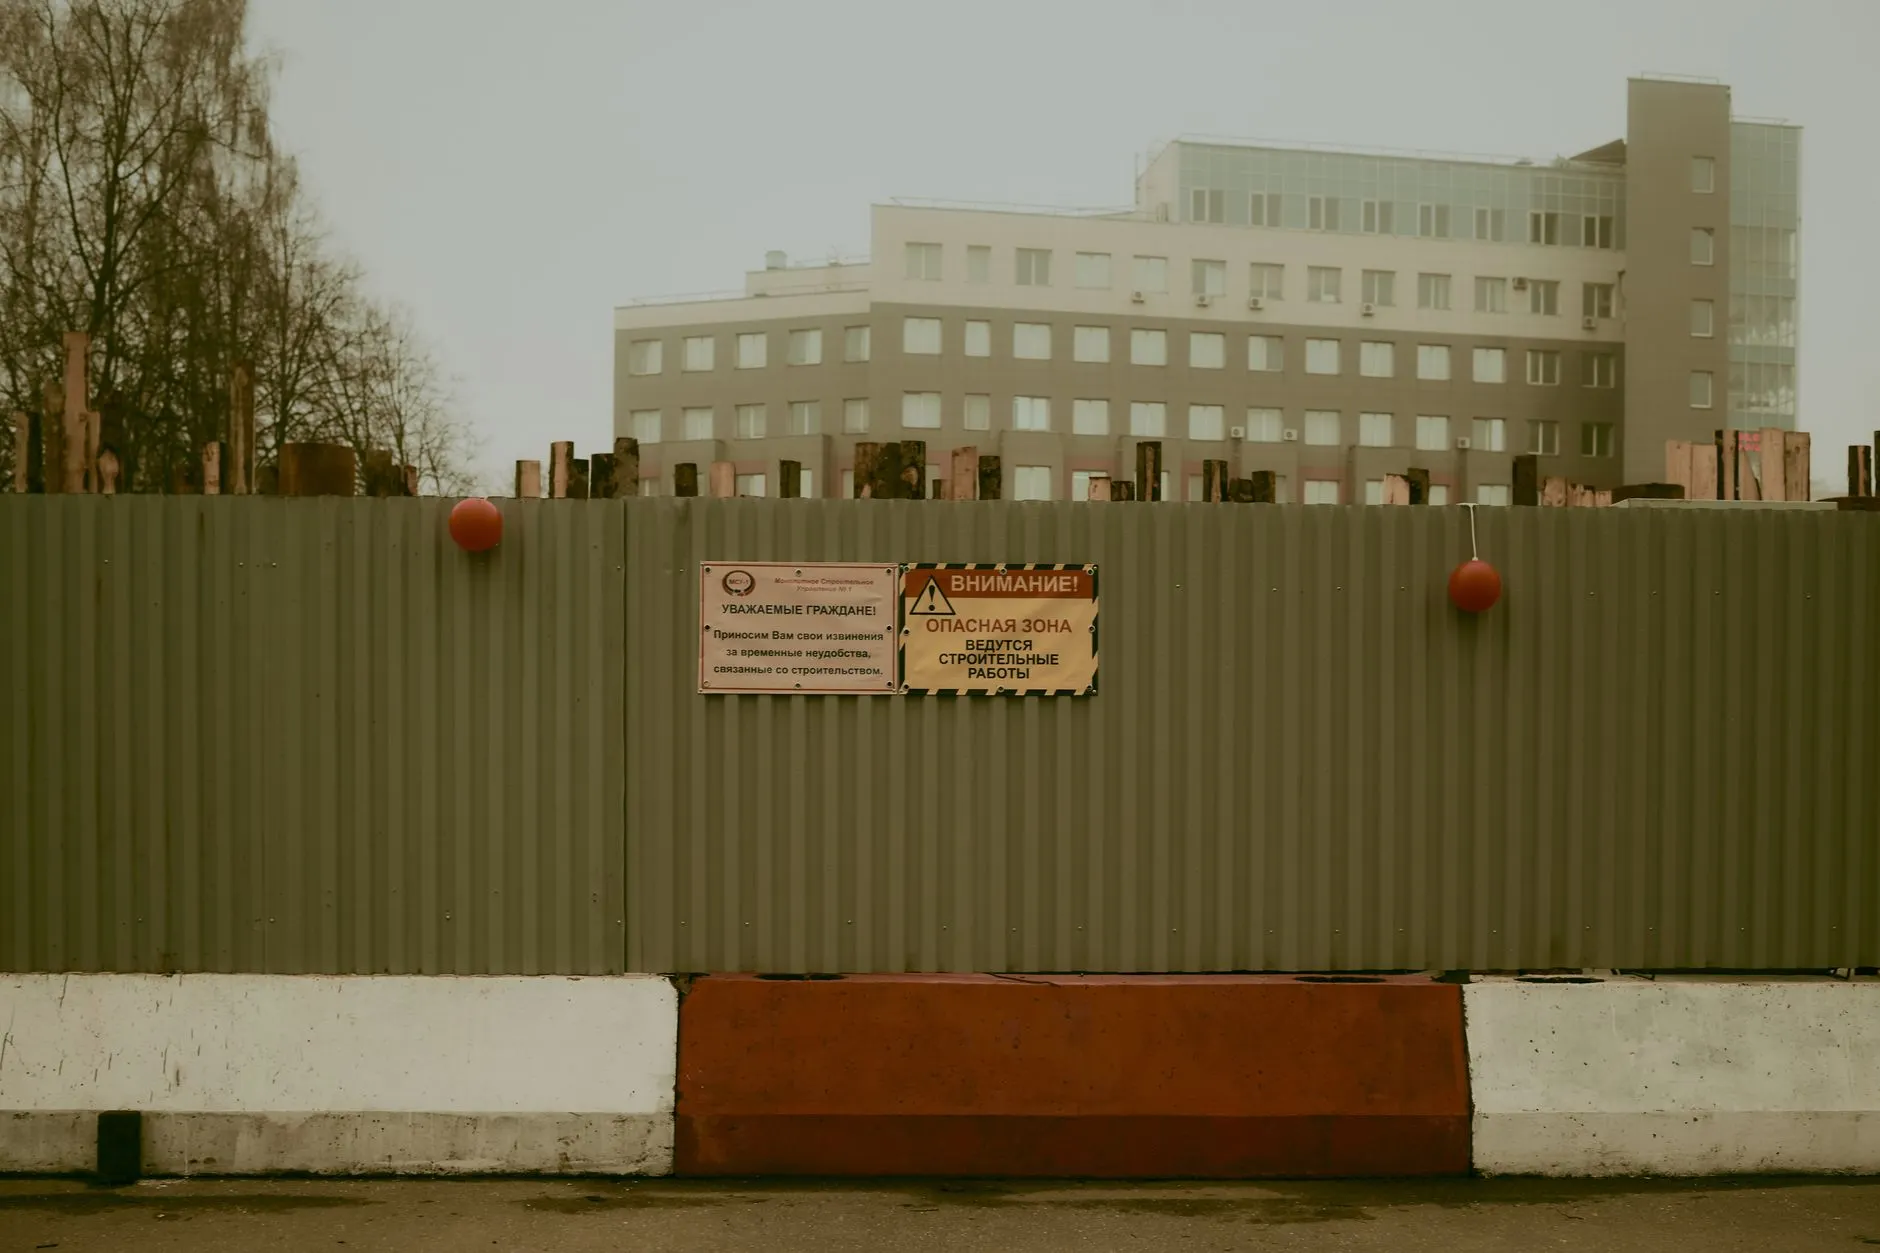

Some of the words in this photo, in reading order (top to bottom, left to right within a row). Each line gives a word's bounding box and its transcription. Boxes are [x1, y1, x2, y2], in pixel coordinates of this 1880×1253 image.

[951, 575, 1078, 592] ВНИМАНИЕ!
[722, 604, 802, 615] УВАЖАЕМЫЕ
[806, 605, 876, 616] ГРАЖДАНЕ!
[926, 618, 1016, 633] ОПАСНАЯ
[1022, 619, 1072, 633] ЗОНА
[714, 630, 768, 641] Приносим
[772, 631, 794, 640] Вам
[826, 633, 883, 641] извинения
[966, 640, 1032, 652] ВЕДУТСЯ
[741, 650, 802, 658] временные
[806, 649, 871, 659] неудобства,
[939, 654, 1059, 665] СТРОИТЕЛЬНЫЕ
[792, 668, 883, 676] строительством.
[968, 668, 1029, 679] РАБОТЫ
